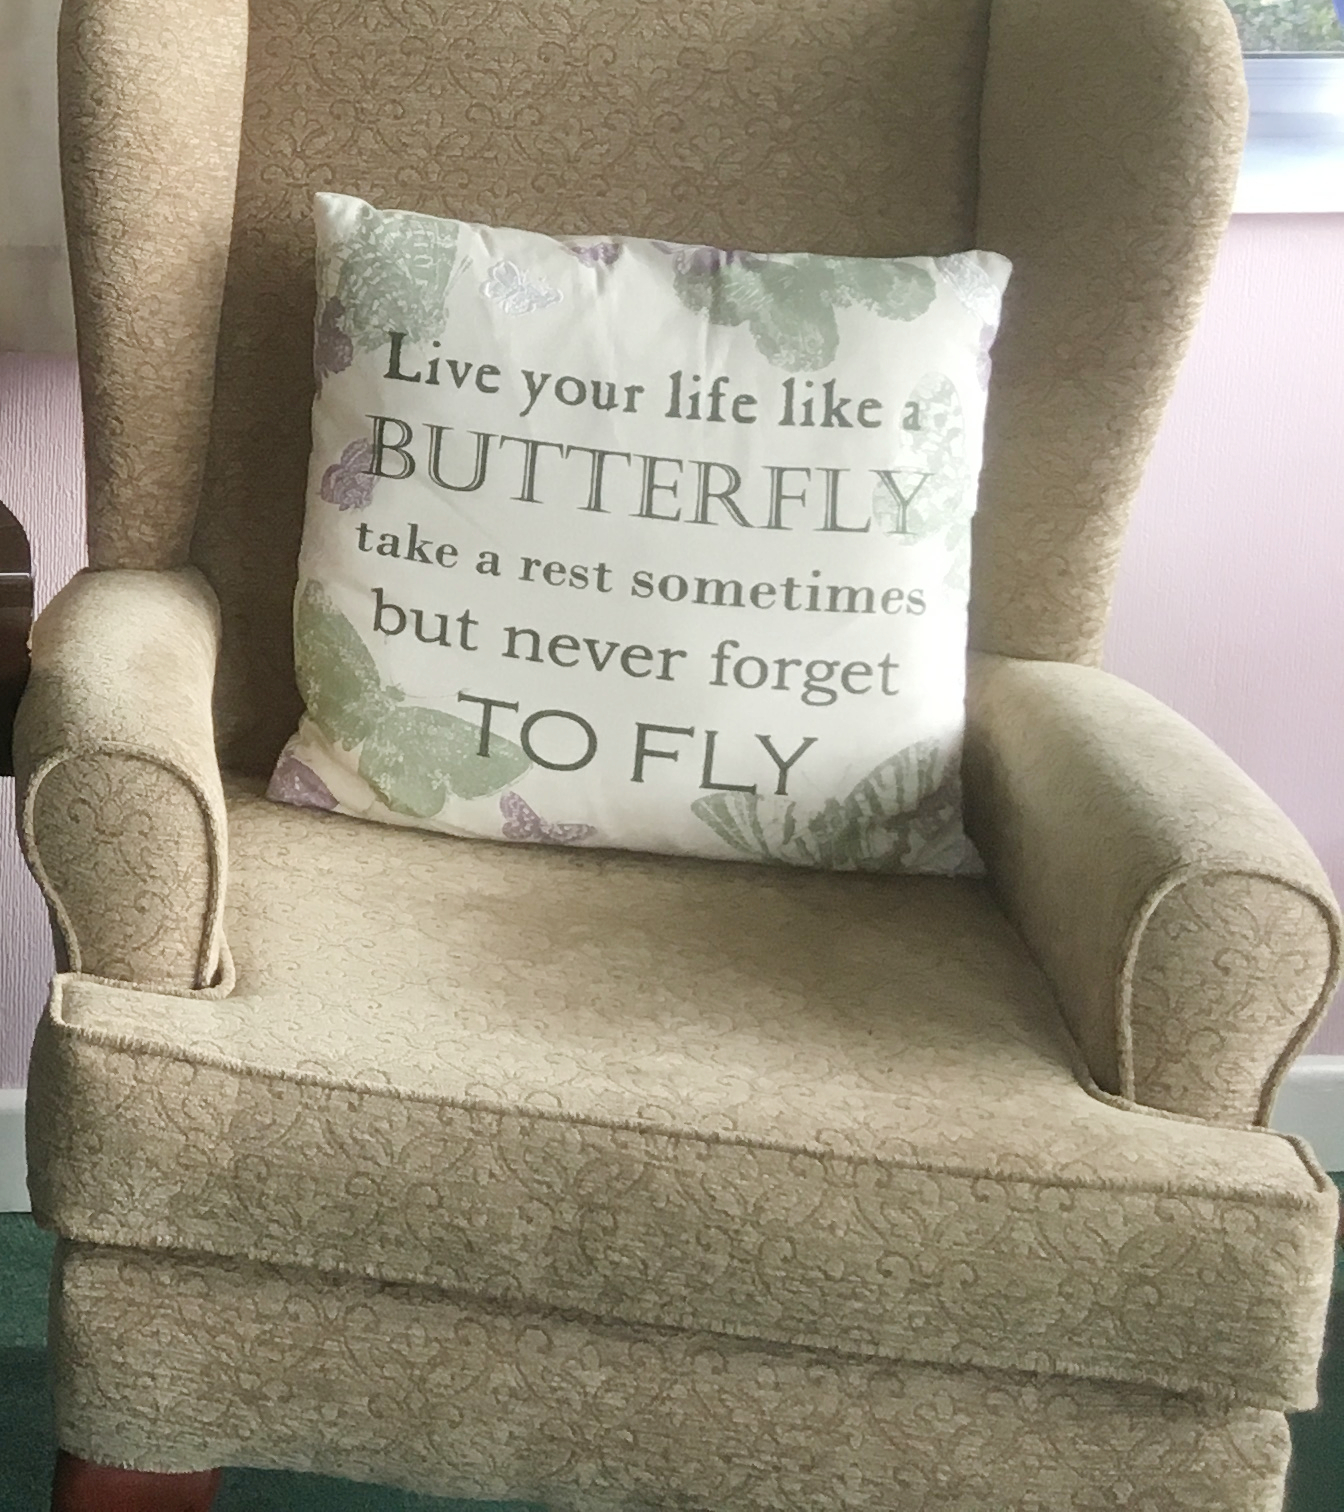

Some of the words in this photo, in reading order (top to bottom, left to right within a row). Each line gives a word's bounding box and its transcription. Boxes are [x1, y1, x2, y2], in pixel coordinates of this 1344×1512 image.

[383, 330, 502, 395] Live
[519, 370, 645, 418] your
[663, 370, 759, 427] life
[777, 376, 883, 430] like
[902, 400, 924, 432] a
[362, 413, 937, 537] BUTTERFLY
[355, 520, 459, 571] take
[475, 548, 502, 578] a
[519, 554, 614, 593] rest
[630, 569, 928, 617] sometimes
[371, 588, 480, 652] but
[500, 620, 688, 683] never
[709, 640, 901, 708] forget
[458, 691, 598, 773] TO
[630, 720, 819, 798] FLY
